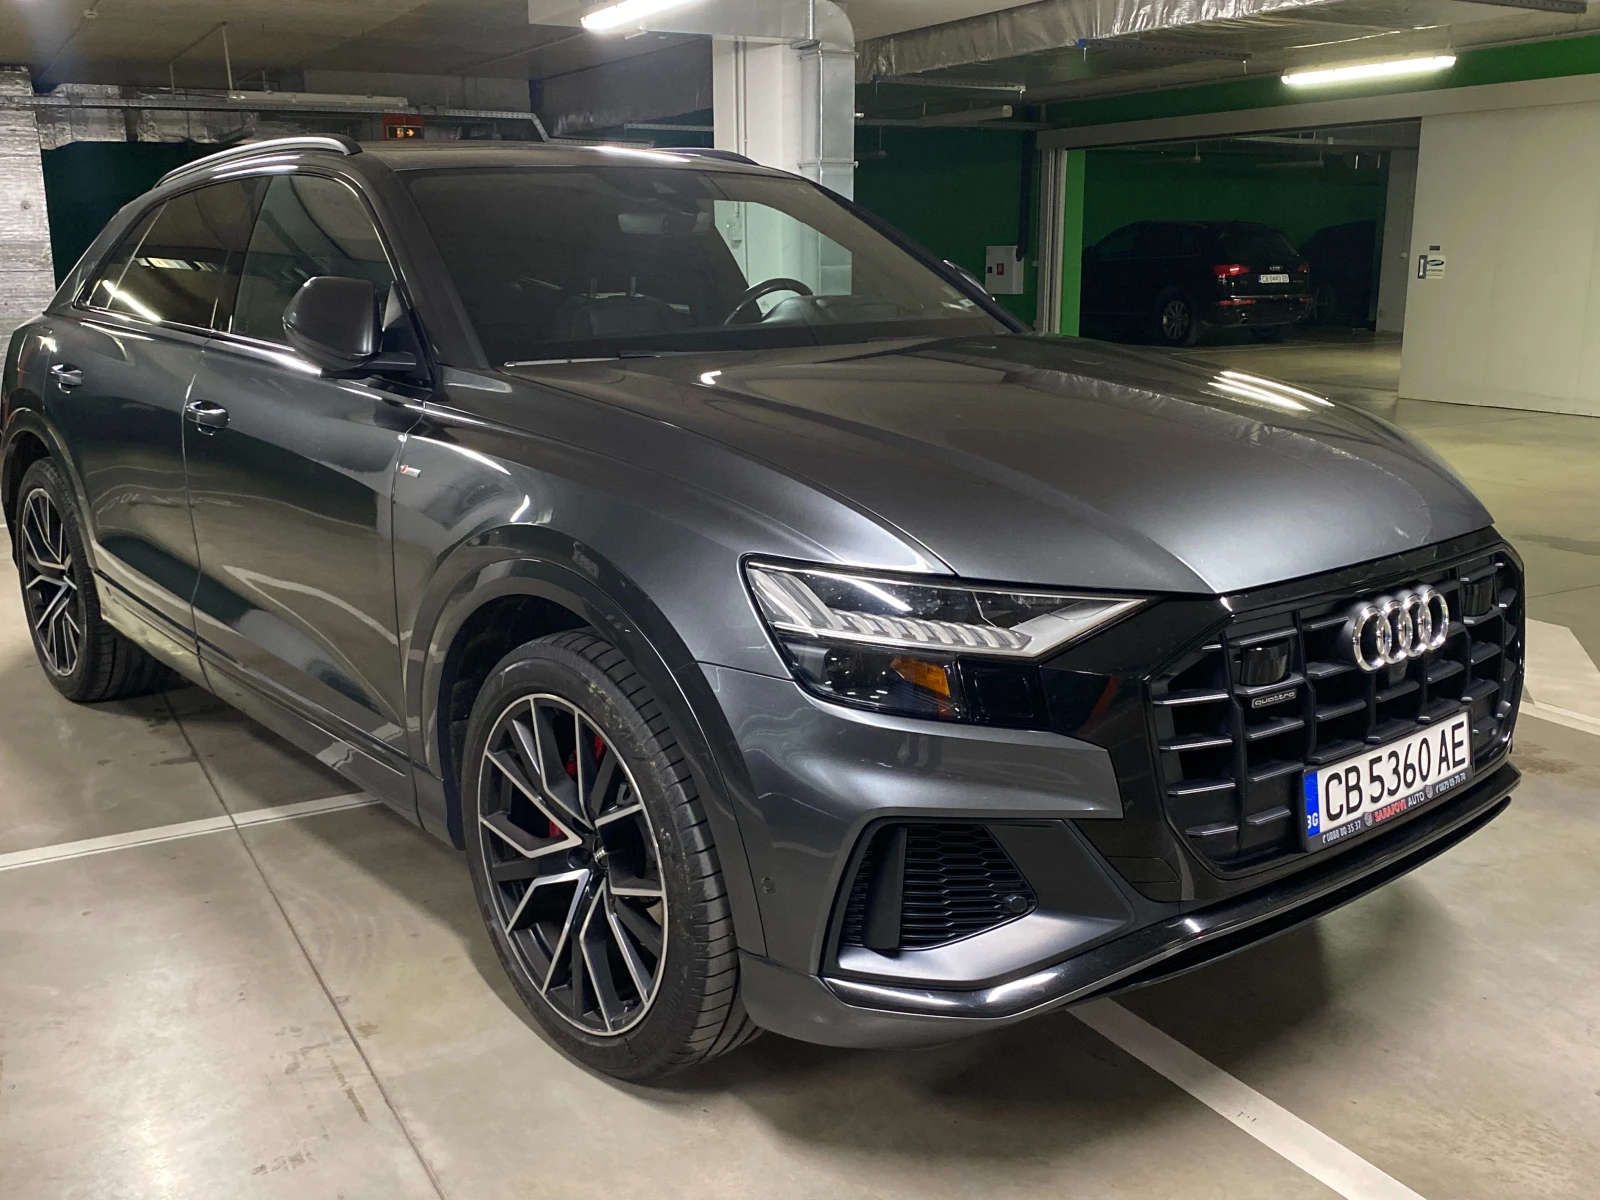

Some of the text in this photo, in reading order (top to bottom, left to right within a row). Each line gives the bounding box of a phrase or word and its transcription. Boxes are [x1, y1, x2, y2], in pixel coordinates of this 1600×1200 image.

[1254, 691, 1295, 706] quattro
[1325, 765, 1363, 822] CB
[1369, 737, 1431, 804] 5360
[1437, 721, 1466, 776] AE
[1347, 823, 1354, 833] 35
[1354, 820, 1361, 830] 37
[1408, 791, 1425, 807] AUTO
